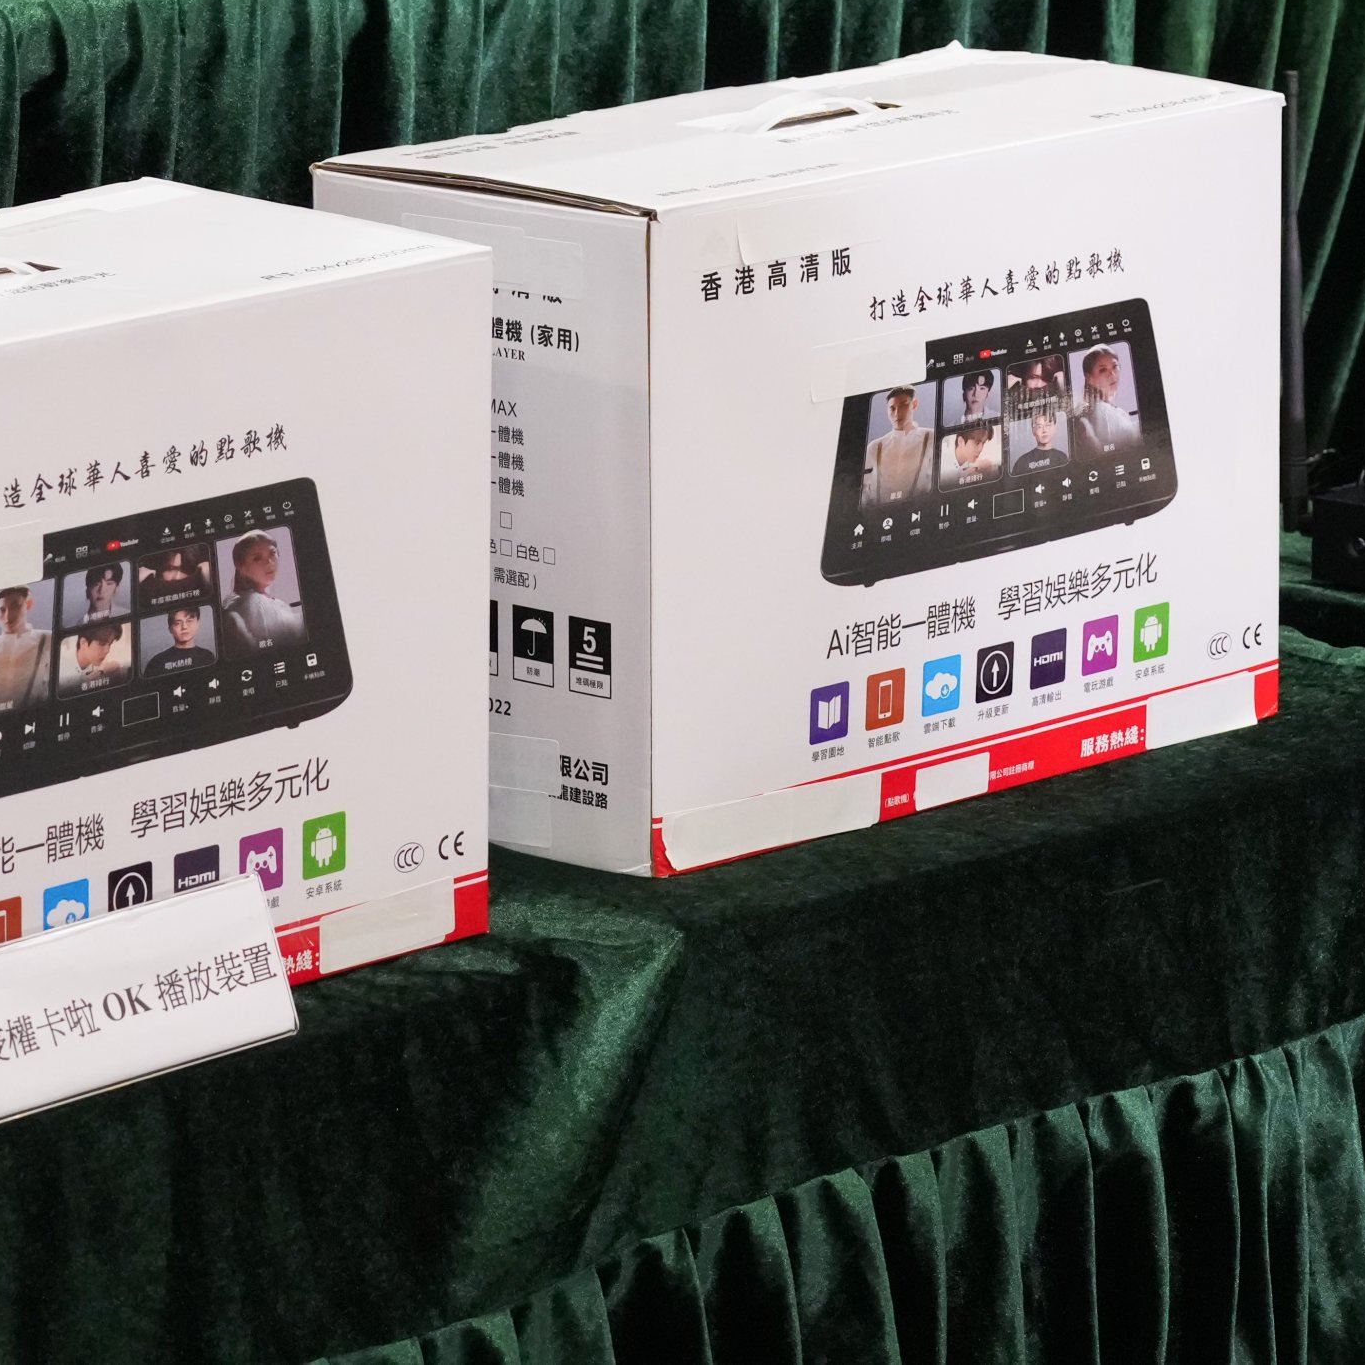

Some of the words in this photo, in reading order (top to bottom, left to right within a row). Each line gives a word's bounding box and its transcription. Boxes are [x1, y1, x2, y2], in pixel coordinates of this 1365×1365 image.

[700, 247, 852, 302] 香港高清版
[530, 324, 581, 353] (家用)
[492, 347, 526, 362] AYER
[516, 543, 540, 563] 白色
[826, 595, 976, 660] Ai智能一體機
[997, 551, 1159, 622] 學習娛樂多元化
[582, 625, 598, 654] 5
[1033, 650, 1064, 667] HDMI
[1134, 664, 1166, 681] 安卓系統
[1031, 690, 1063, 708] 高清輸出
[977, 704, 1010, 722] 升級更新
[923, 718, 956, 735] 雲端下載
[867, 730, 901, 749] 智能點歌
[129, 756, 332, 840] 學習娛樂多元化
[177, 870, 217, 891] HDMI
[305, 879, 343, 900] 安卓系統
[101, 982, 153, 1023] OK
[154, 941, 278, 1012] 播放裝置
